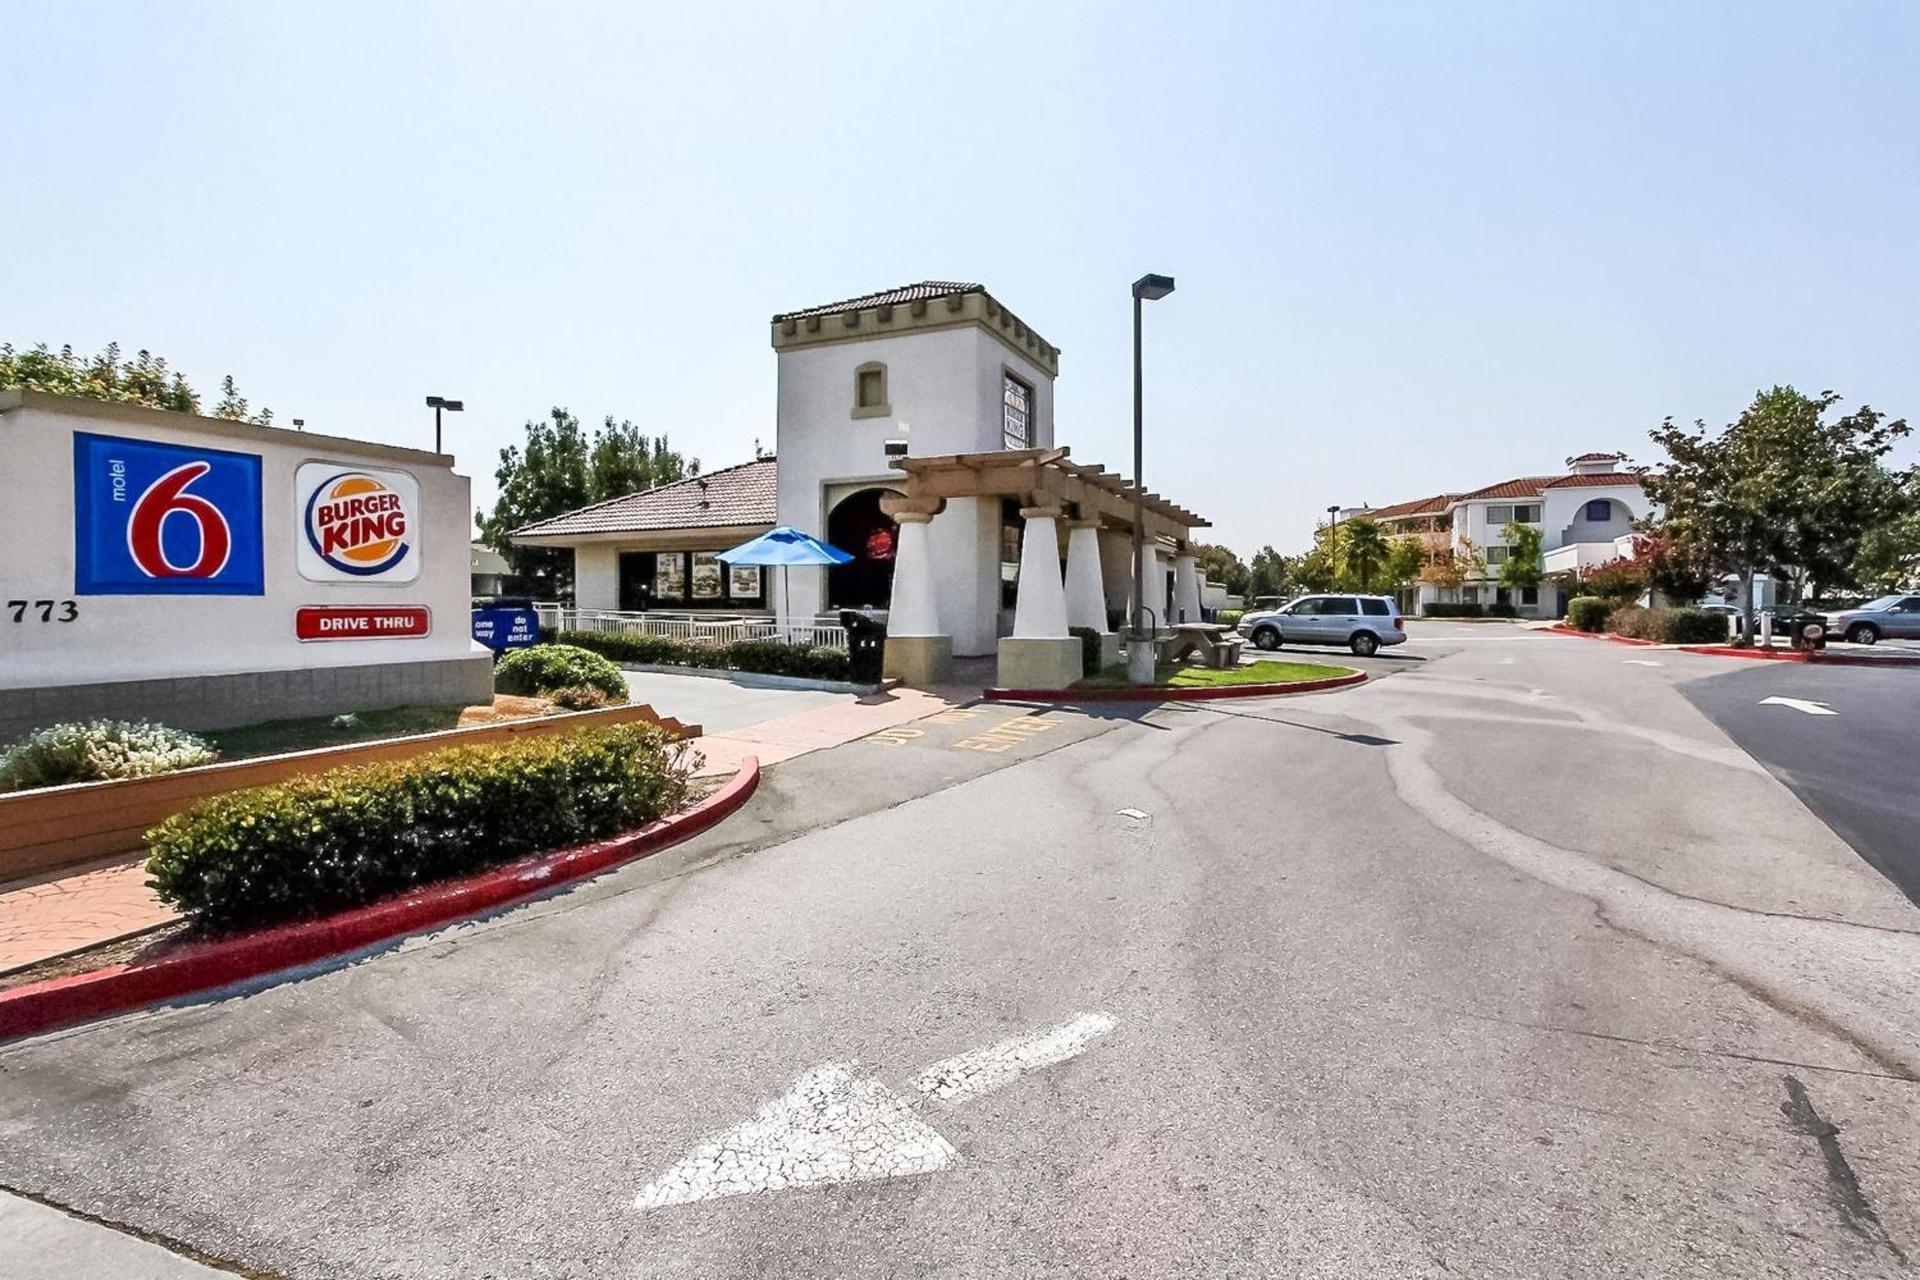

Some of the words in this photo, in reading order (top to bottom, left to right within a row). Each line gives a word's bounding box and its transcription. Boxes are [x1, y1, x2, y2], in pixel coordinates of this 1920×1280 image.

[318, 493, 401, 527] BURGER
[127, 461, 231, 578] 6
[322, 511, 406, 555] KING
[7, 600, 79, 623] 773
[320, 617, 369, 631] DRIVE
[373, 616, 414, 629] THRU
[475, 621, 494, 629] one
[514, 616, 527, 625] do
[475, 630, 495, 639] way
[512, 625, 528, 633] not
[507, 634, 534, 642] enter
